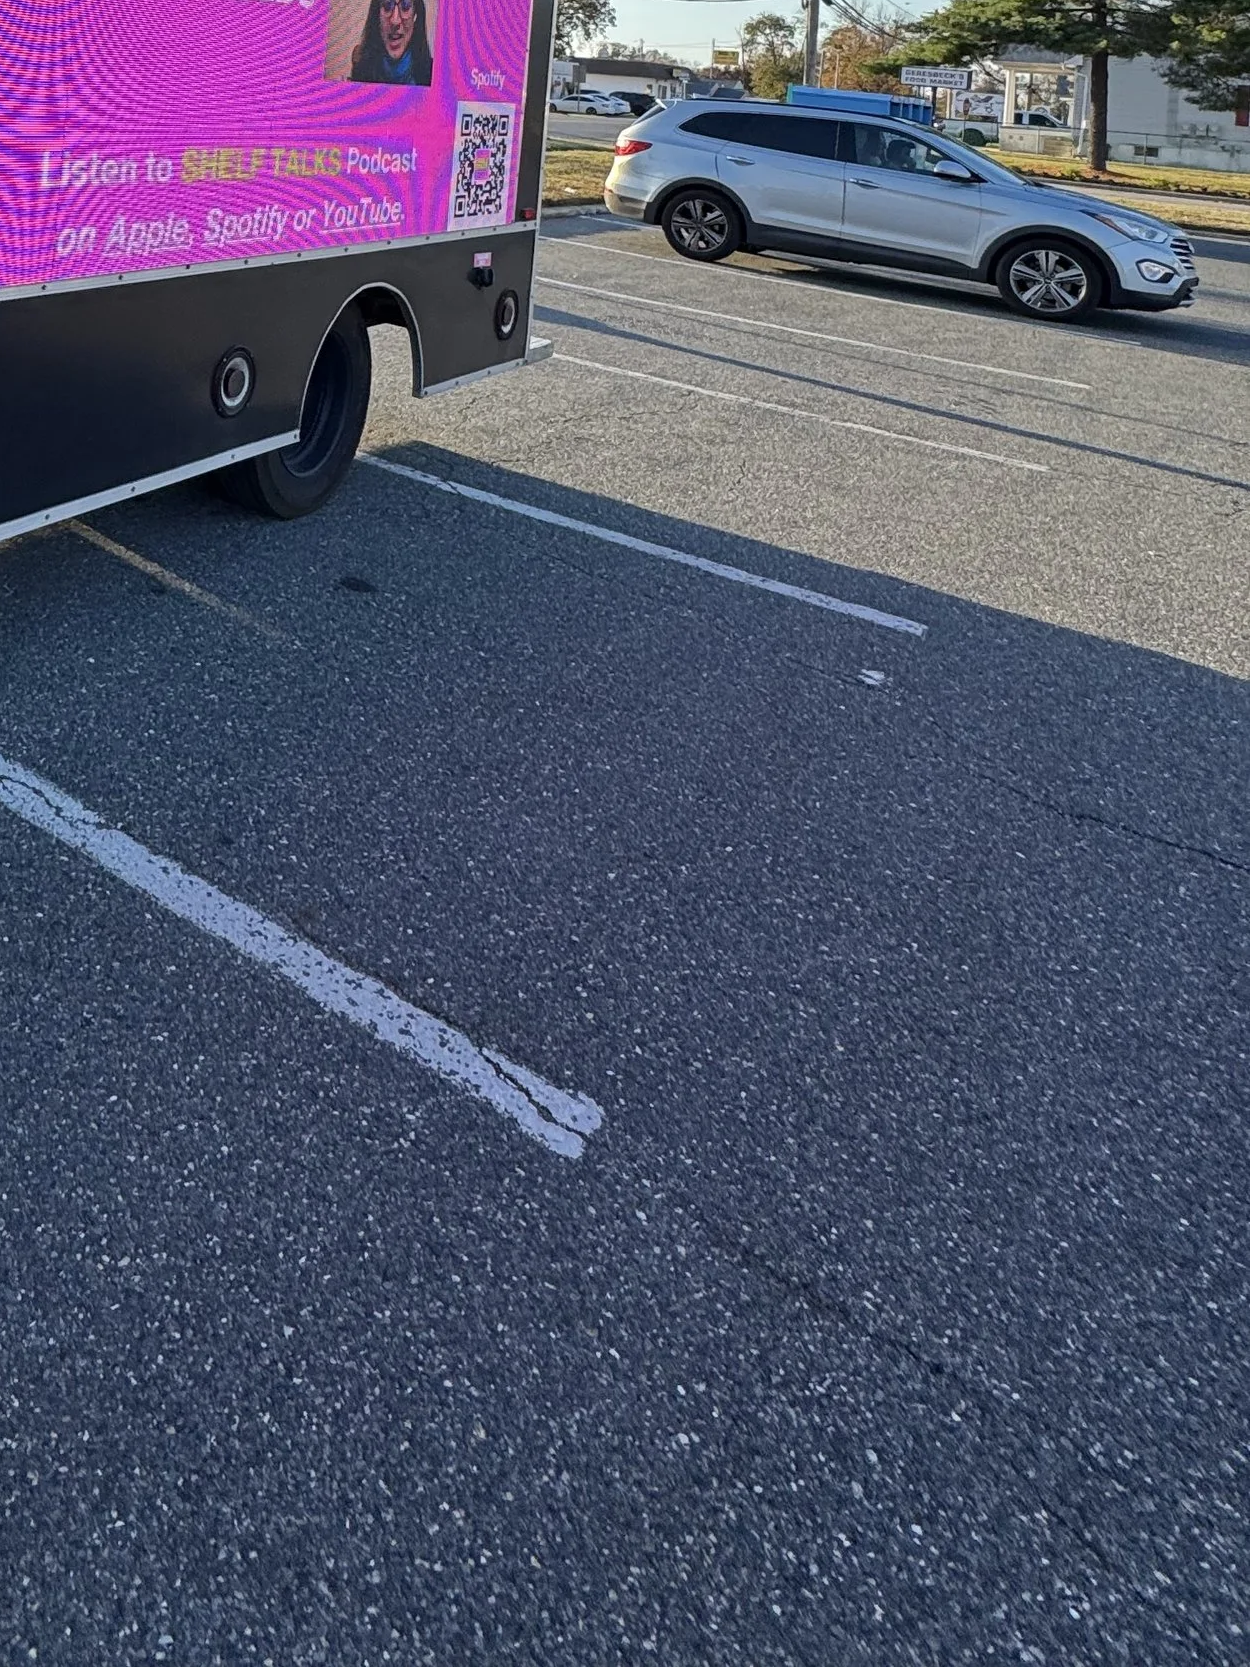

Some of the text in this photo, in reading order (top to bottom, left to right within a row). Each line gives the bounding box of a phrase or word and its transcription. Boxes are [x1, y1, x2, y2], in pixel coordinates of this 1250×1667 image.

[470, 67, 506, 91] Spotify
[930, 78, 964, 86] MARKET
[41, 146, 418, 187] Listen to SHELF TALKS Podcast
[57, 227, 96, 256] on
[204, 204, 288, 248] Spotify
[293, 207, 317, 231] or
[320, 197, 405, 230] YouTube.
